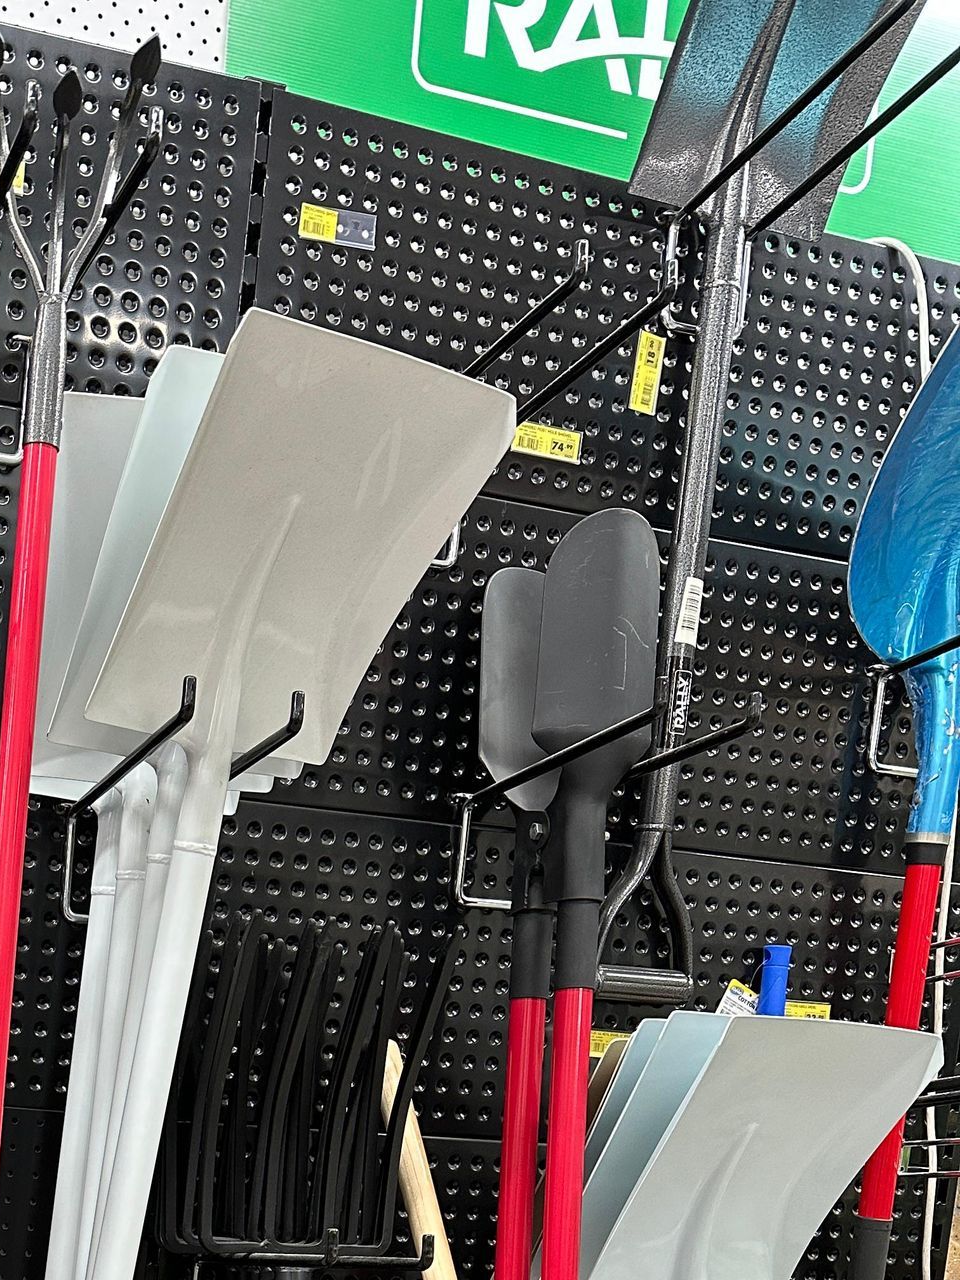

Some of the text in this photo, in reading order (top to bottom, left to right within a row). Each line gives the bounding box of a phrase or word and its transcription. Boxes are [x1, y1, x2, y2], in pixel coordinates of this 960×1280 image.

[552, 440, 573, 452] 74.99
[674, 676, 689, 730] RALLY
[738, 995, 756, 1010] COTTON
